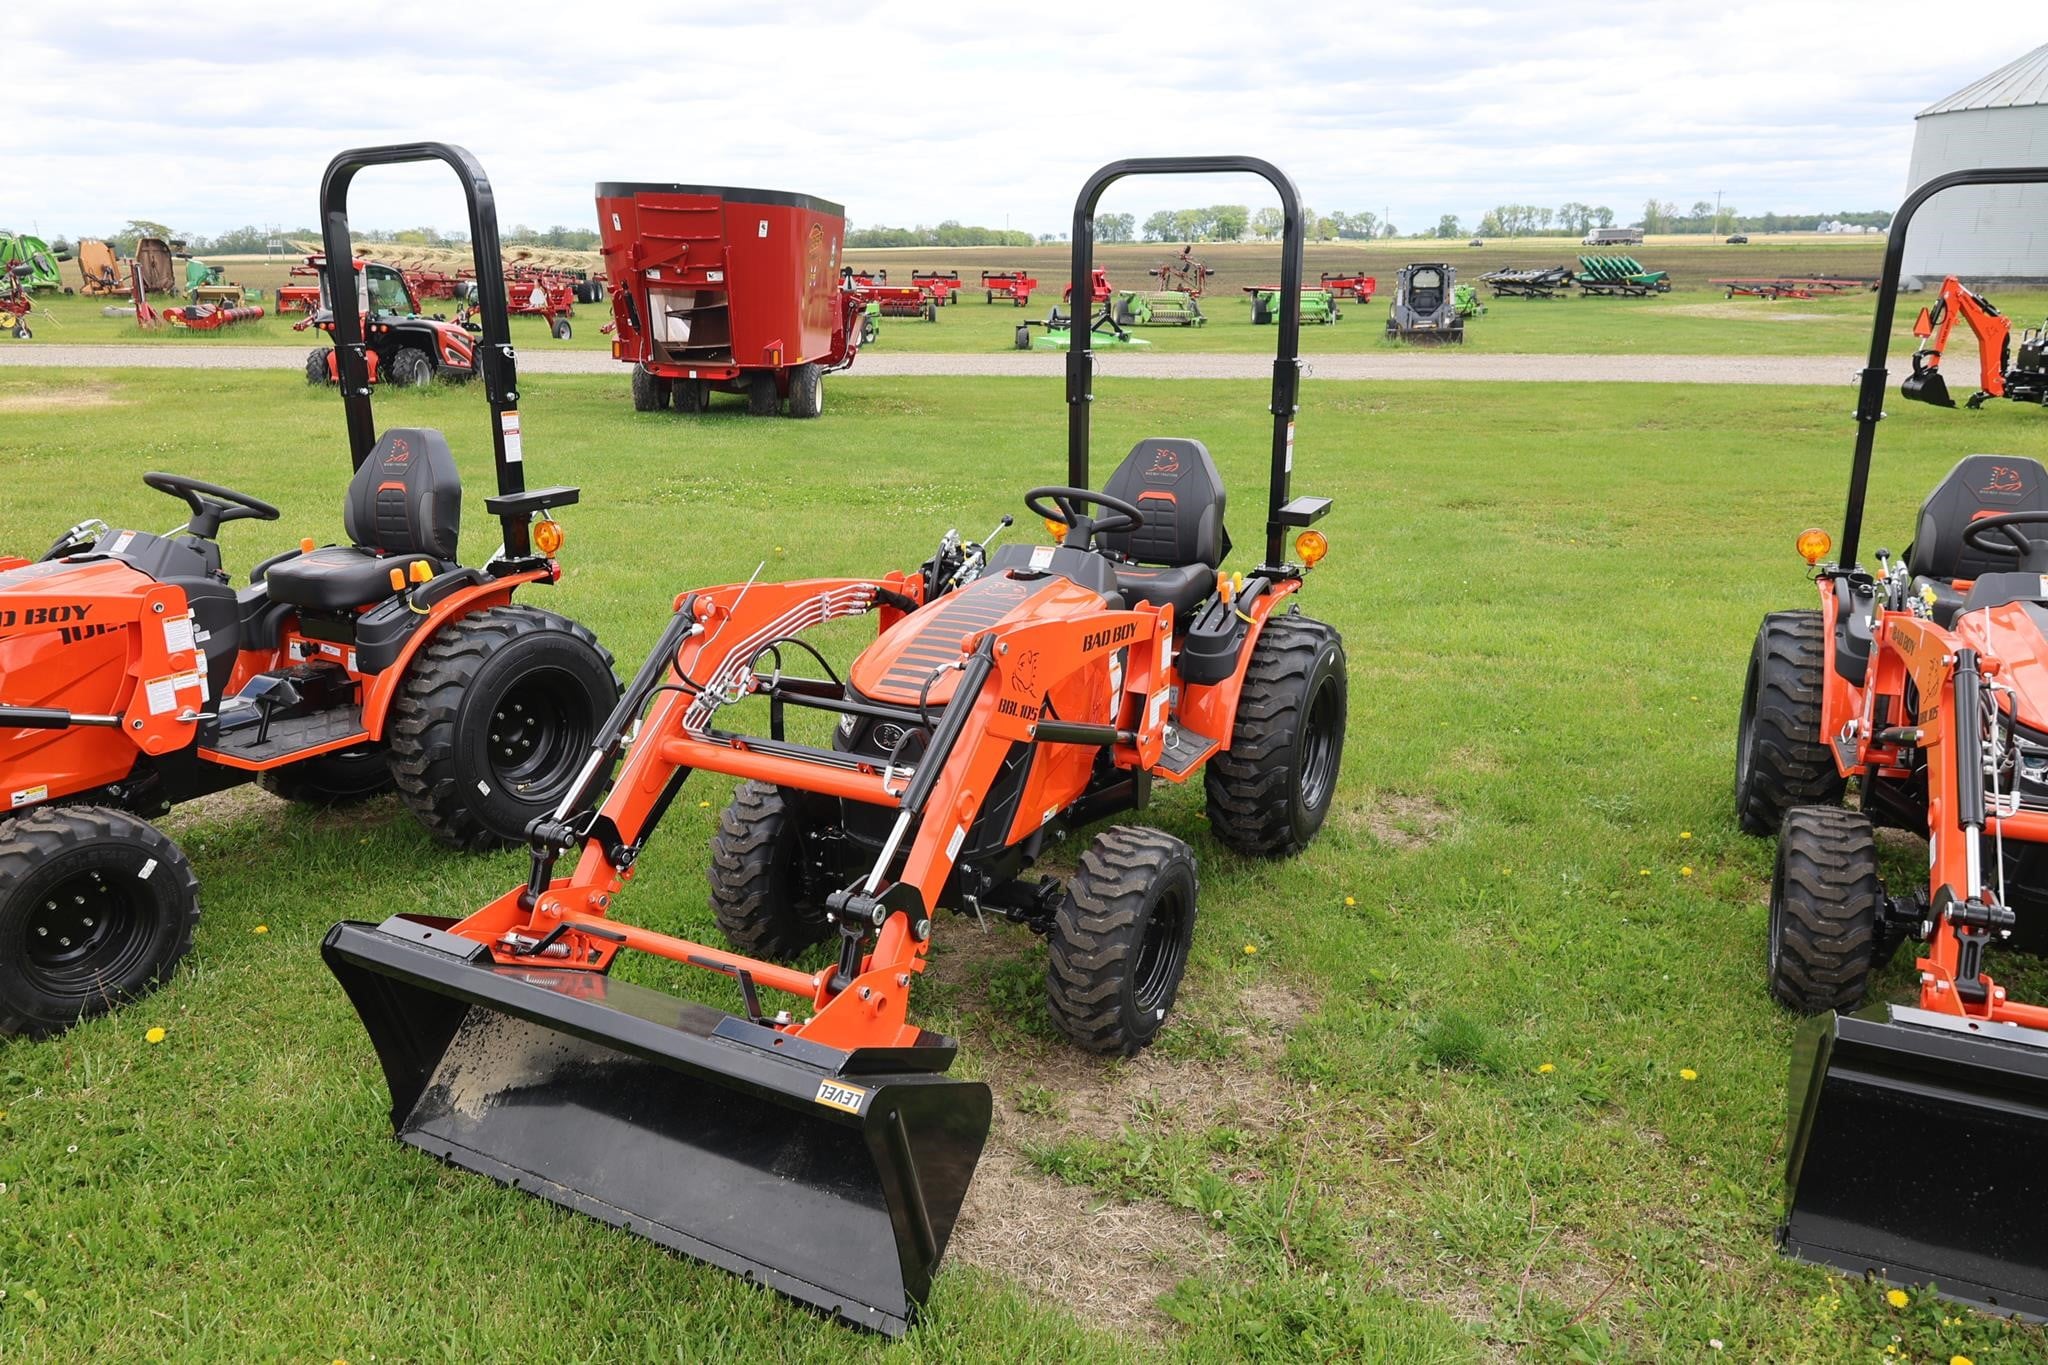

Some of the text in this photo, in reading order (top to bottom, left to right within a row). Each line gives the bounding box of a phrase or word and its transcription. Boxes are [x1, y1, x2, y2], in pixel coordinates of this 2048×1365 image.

[24, 603, 93, 626] BOY
[1082, 621, 1138, 653] BAD BOY
[997, 698, 1039, 721] BBL 105
[820, 1084, 862, 1107] LEVEL
